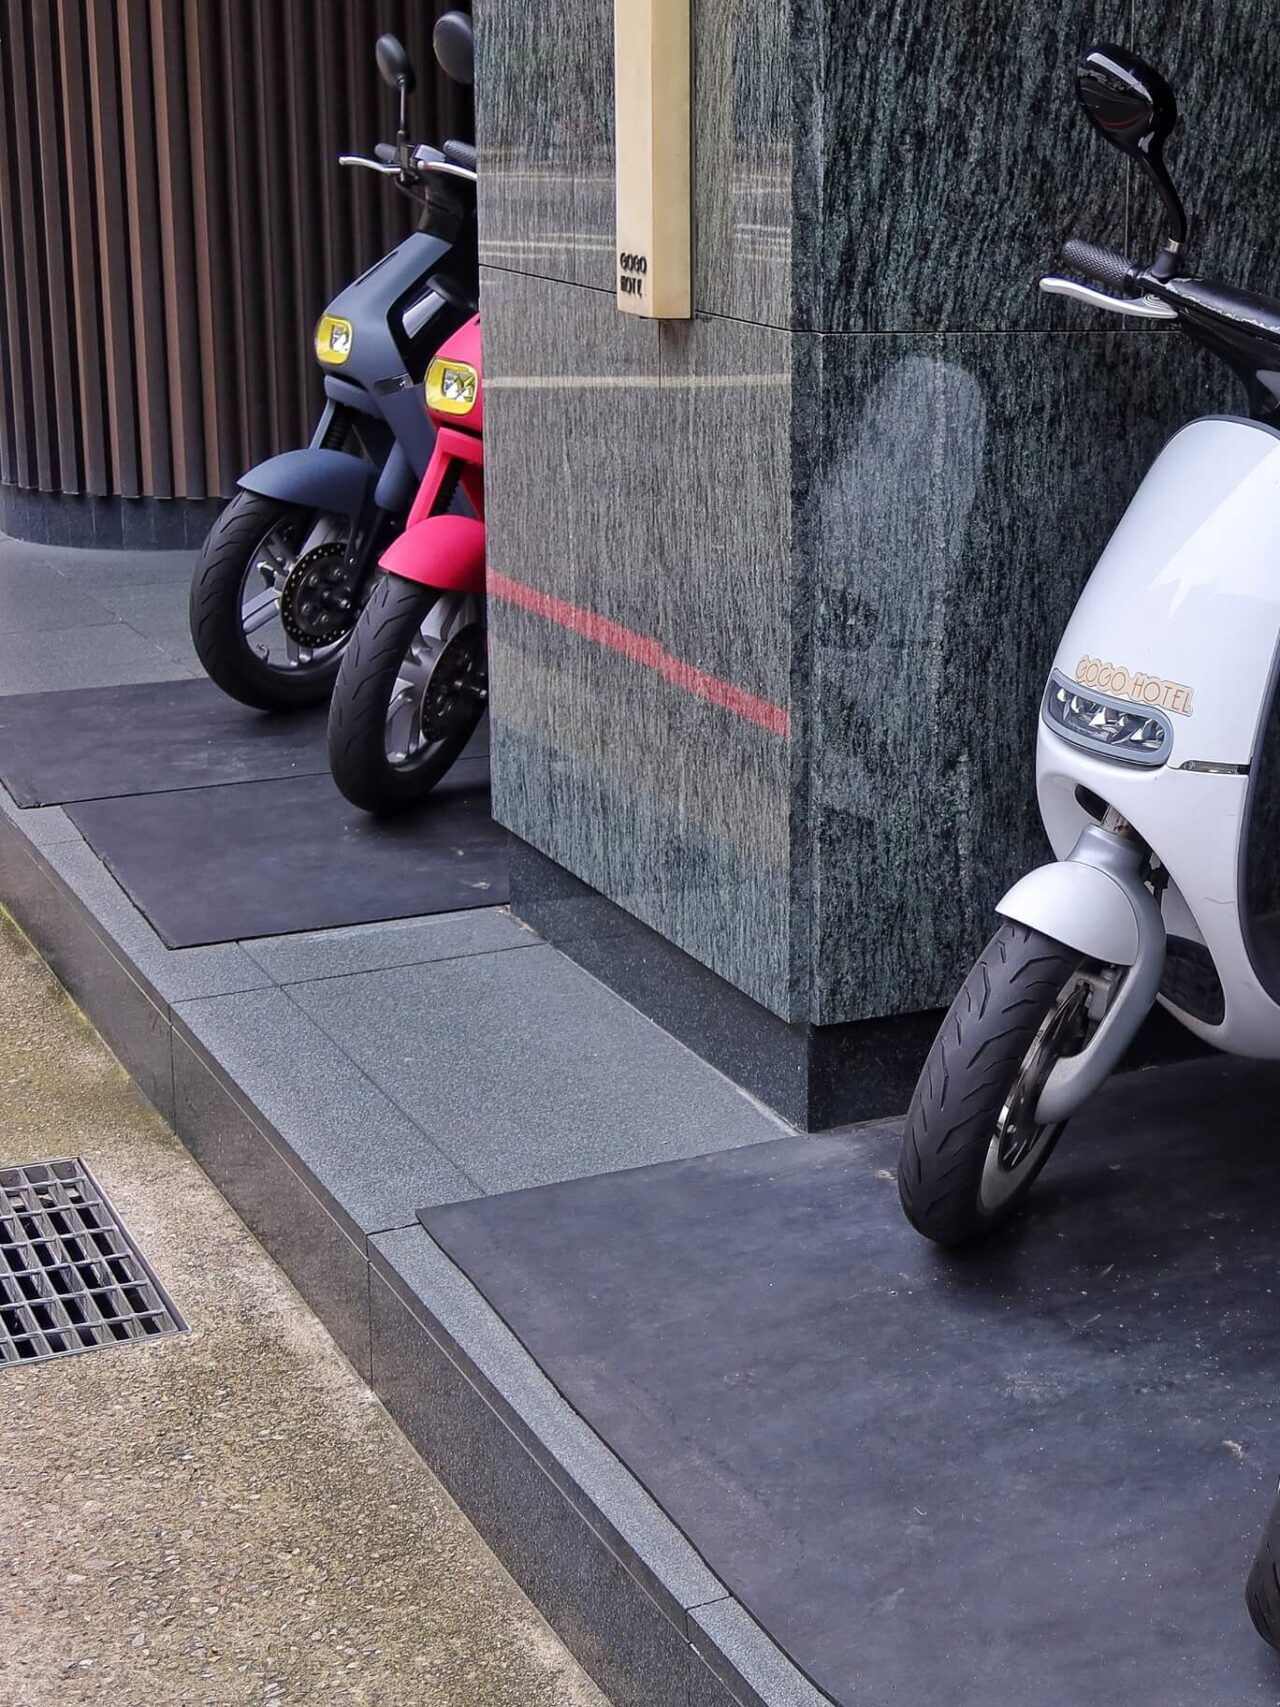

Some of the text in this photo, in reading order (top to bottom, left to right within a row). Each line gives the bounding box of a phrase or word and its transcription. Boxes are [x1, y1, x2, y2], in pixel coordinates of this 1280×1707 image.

[620, 252, 647, 274] GOGO
[1076, 659, 1190, 713] GOGO HOTEL
